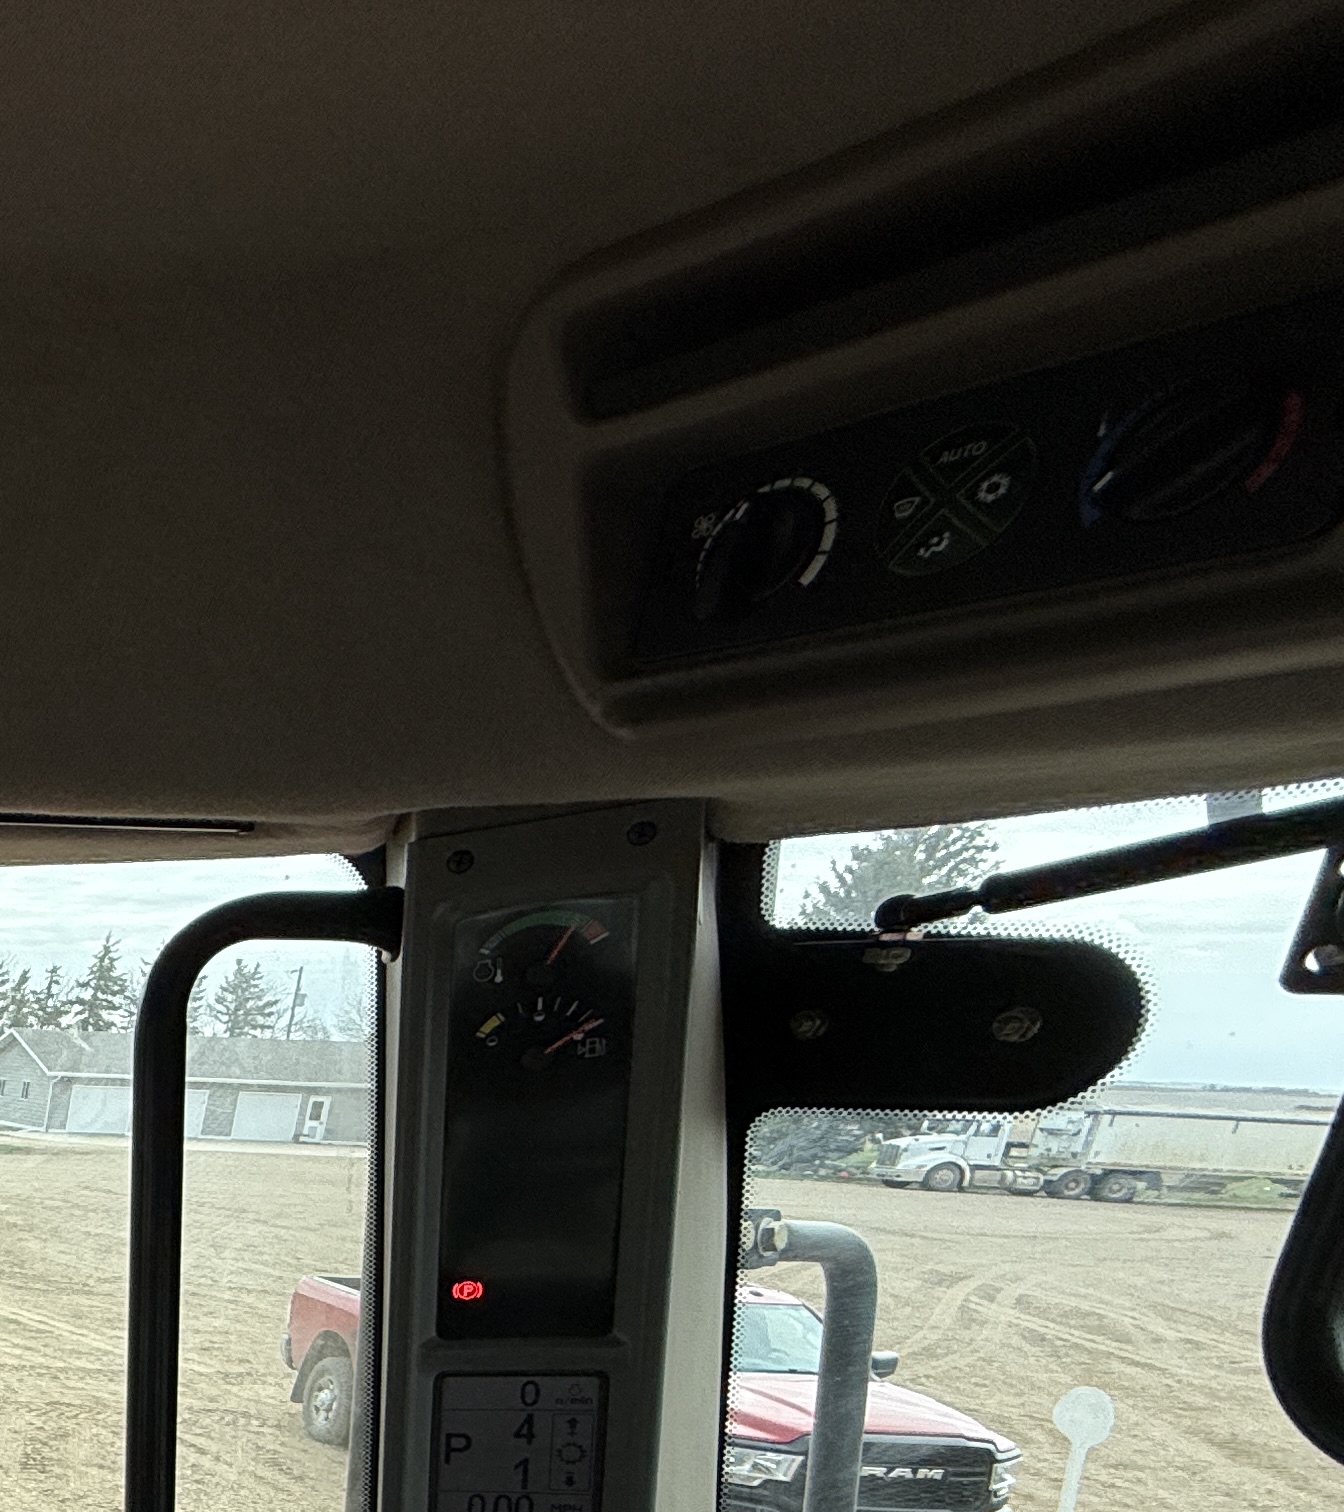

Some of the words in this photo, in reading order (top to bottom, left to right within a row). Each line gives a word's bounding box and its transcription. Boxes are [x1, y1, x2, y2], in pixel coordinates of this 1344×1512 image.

[938, 442, 988, 464] AUTO
[520, 1379, 541, 1407] 0
[513, 1412, 536, 1446] 4
[444, 1432, 473, 1465] P
[513, 1456, 531, 1490] 1
[859, 1466, 946, 1481] RAM
